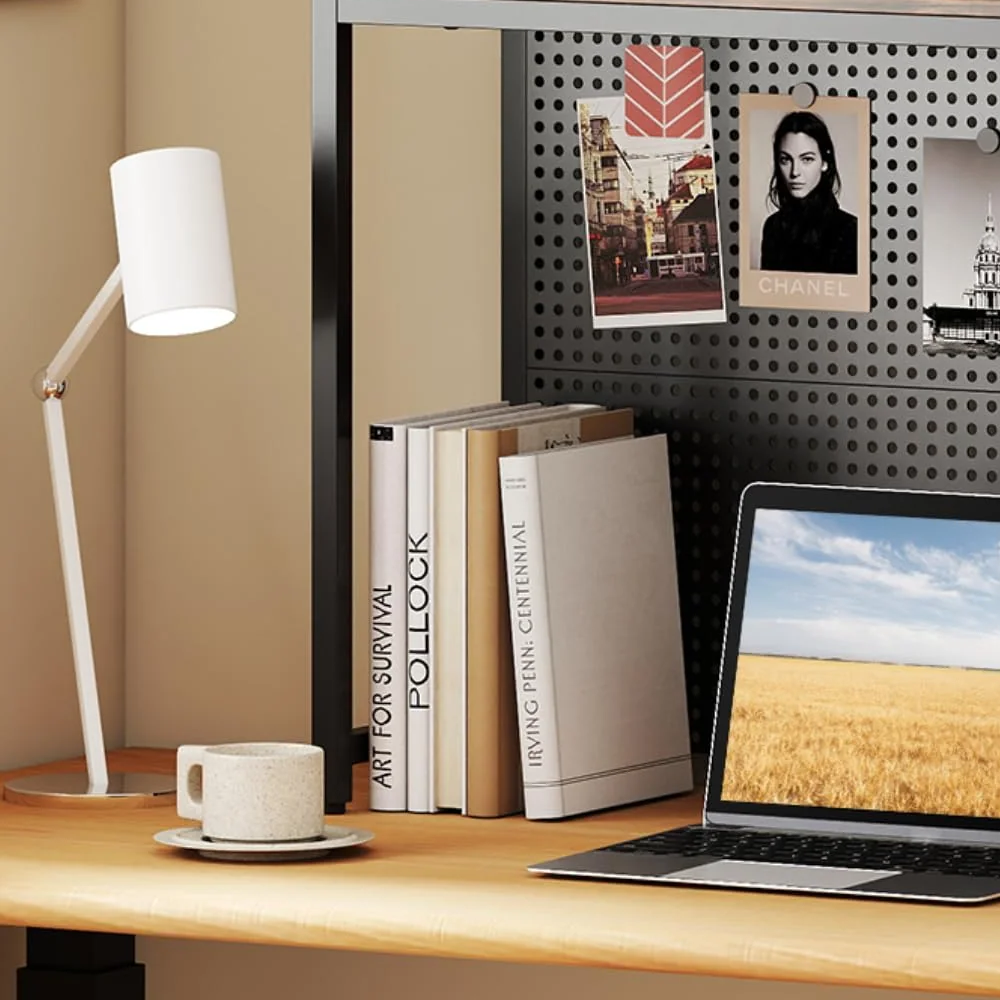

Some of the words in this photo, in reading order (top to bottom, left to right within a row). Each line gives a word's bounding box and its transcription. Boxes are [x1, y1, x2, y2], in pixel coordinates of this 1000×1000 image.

[758, 276, 849, 297] CHANEL
[512, 520, 534, 634] CENTENNIAL
[371, 584, 393, 685] SURVIVAL
[408, 532, 430, 709] POLLOCK
[520, 640, 537, 692] PENN:
[371, 693, 392, 738] FOR
[524, 700, 544, 767] IRVING
[371, 746, 392, 789] ART
